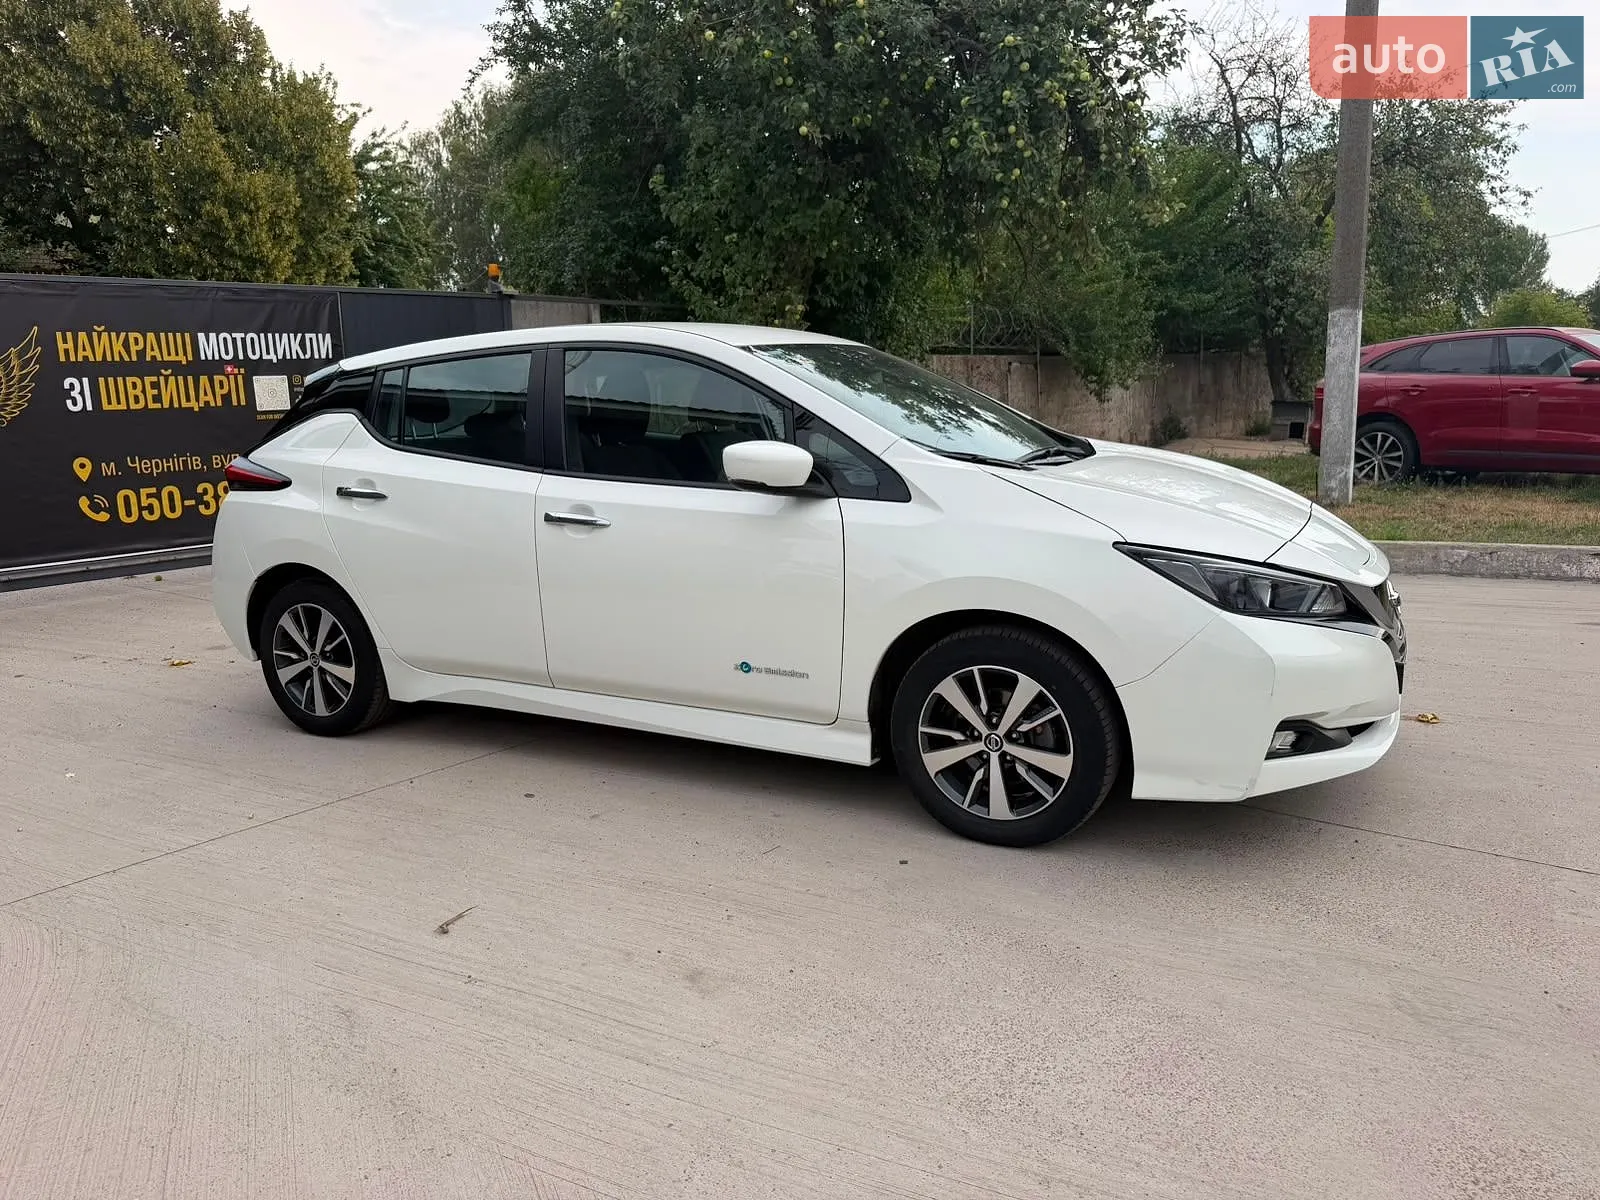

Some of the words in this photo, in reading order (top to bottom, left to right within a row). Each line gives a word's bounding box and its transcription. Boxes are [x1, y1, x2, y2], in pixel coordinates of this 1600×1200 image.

[55, 325, 193, 364] НАЙКРАЩІ
[197, 332, 333, 363] МОТОЦИКЛИ
[63, 377, 93, 412] ЗІ
[98, 367, 246, 412] ШВЕЙЦАРІЇ
[101, 463, 122, 477] м.
[127, 453, 207, 475] Чернігів,
